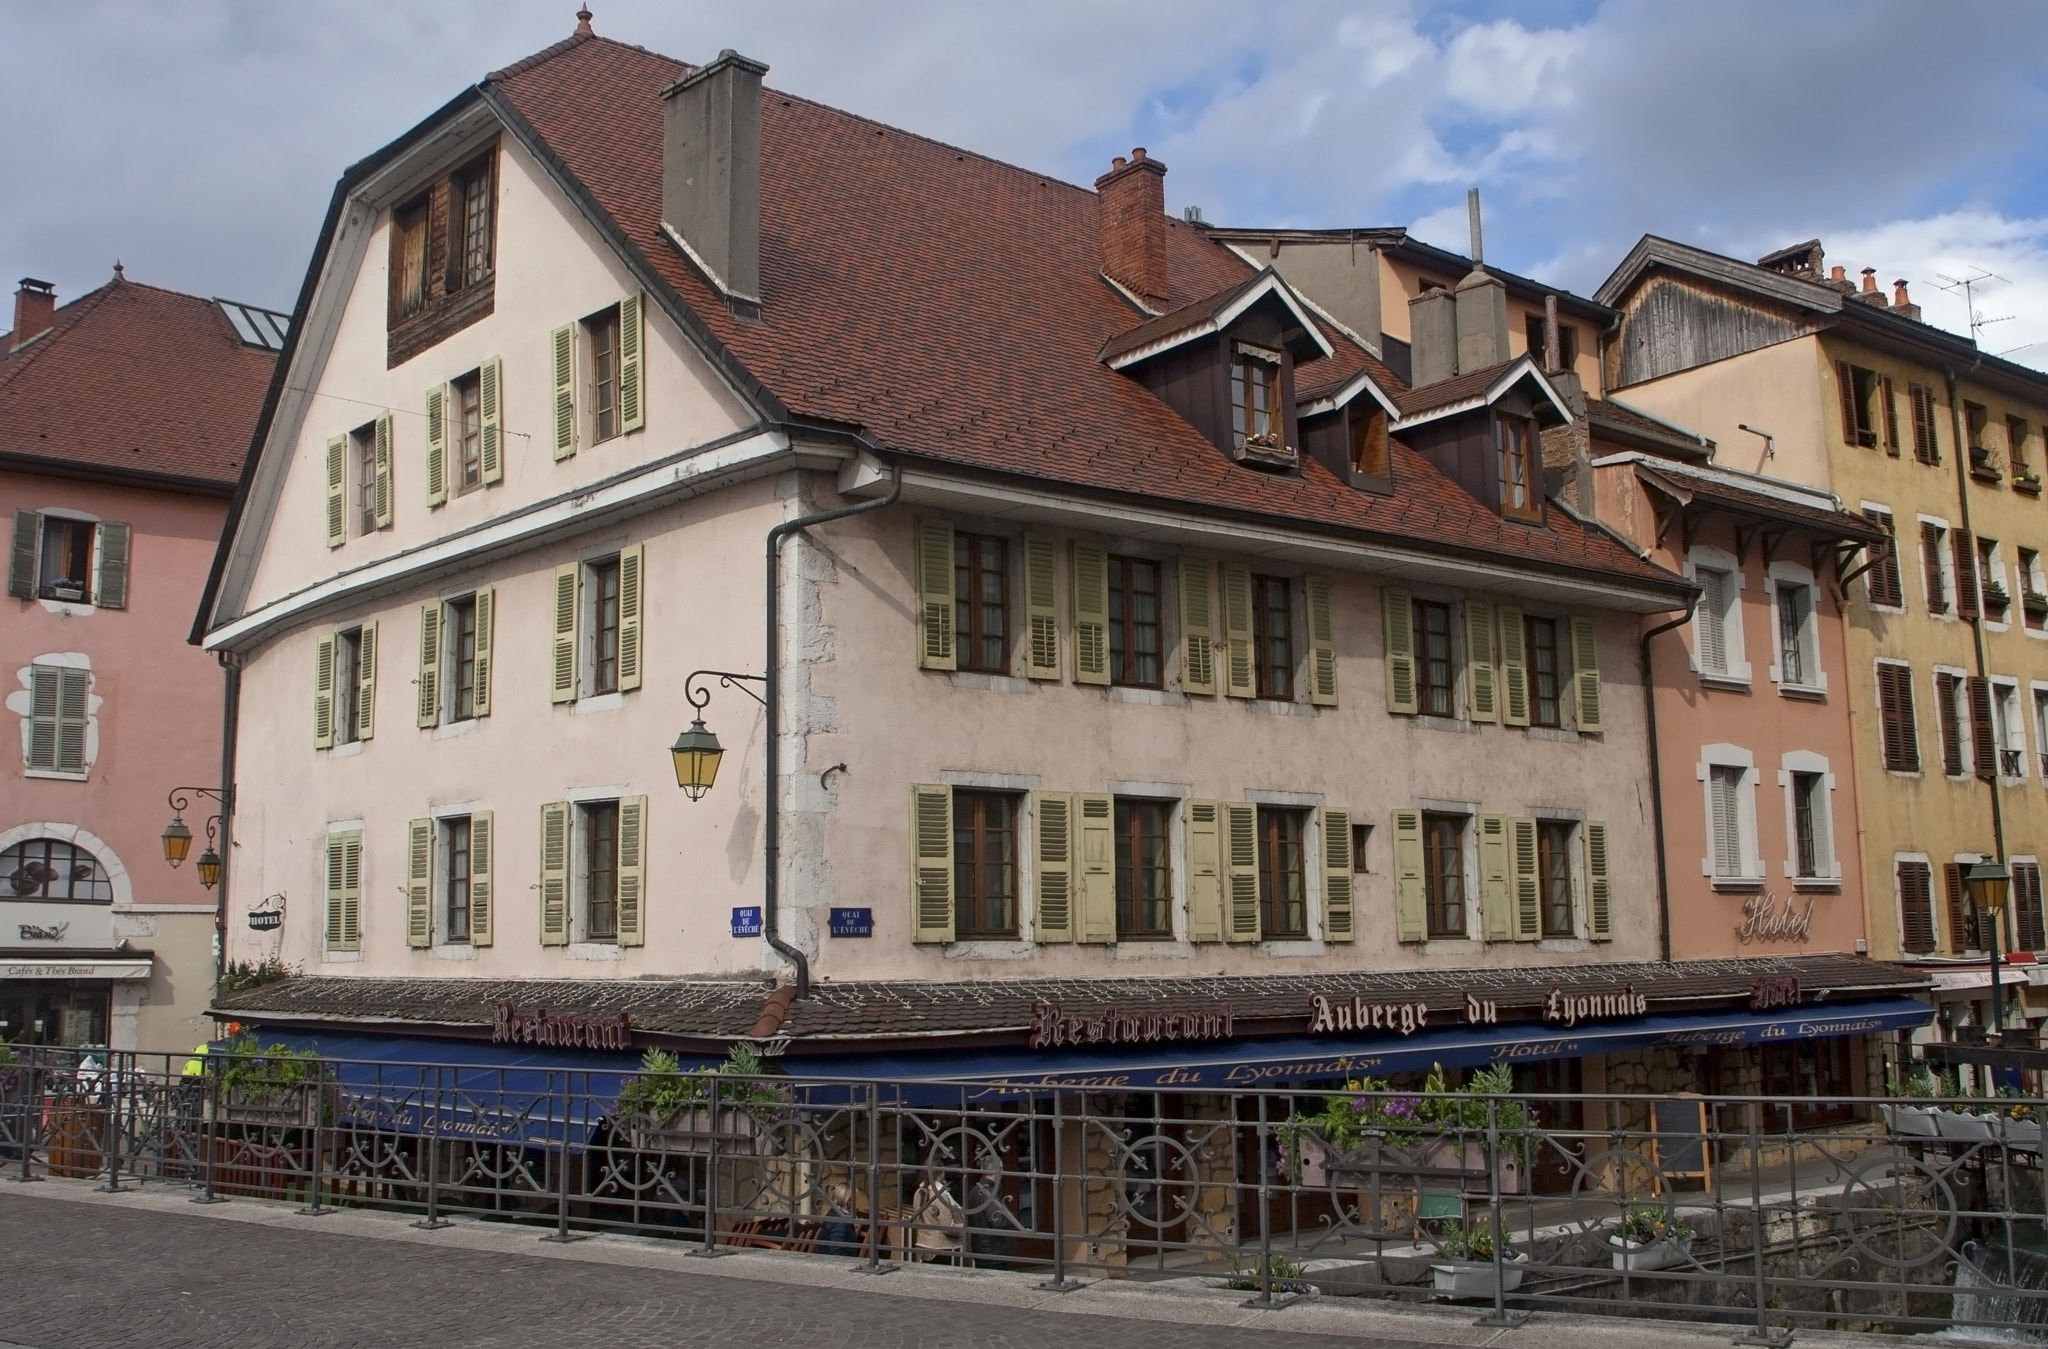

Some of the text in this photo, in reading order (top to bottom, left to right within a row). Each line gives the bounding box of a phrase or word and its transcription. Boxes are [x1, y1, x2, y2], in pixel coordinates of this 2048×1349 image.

[250, 916, 280, 925] HOTEL
[1740, 892, 1813, 937] Hotel
[35, 966, 43, 975] &
[68, 966, 94, 975] Brand
[492, 1001, 632, 1050] Restaurant
[1030, 1003, 1234, 1049] Restaurant
[1308, 982, 1647, 1036] Auberge du Lyonnais
[1760, 1024, 1787, 1038] du
[967, 1074, 1130, 1098] Auberge
[1155, 1066, 1201, 1084] du
